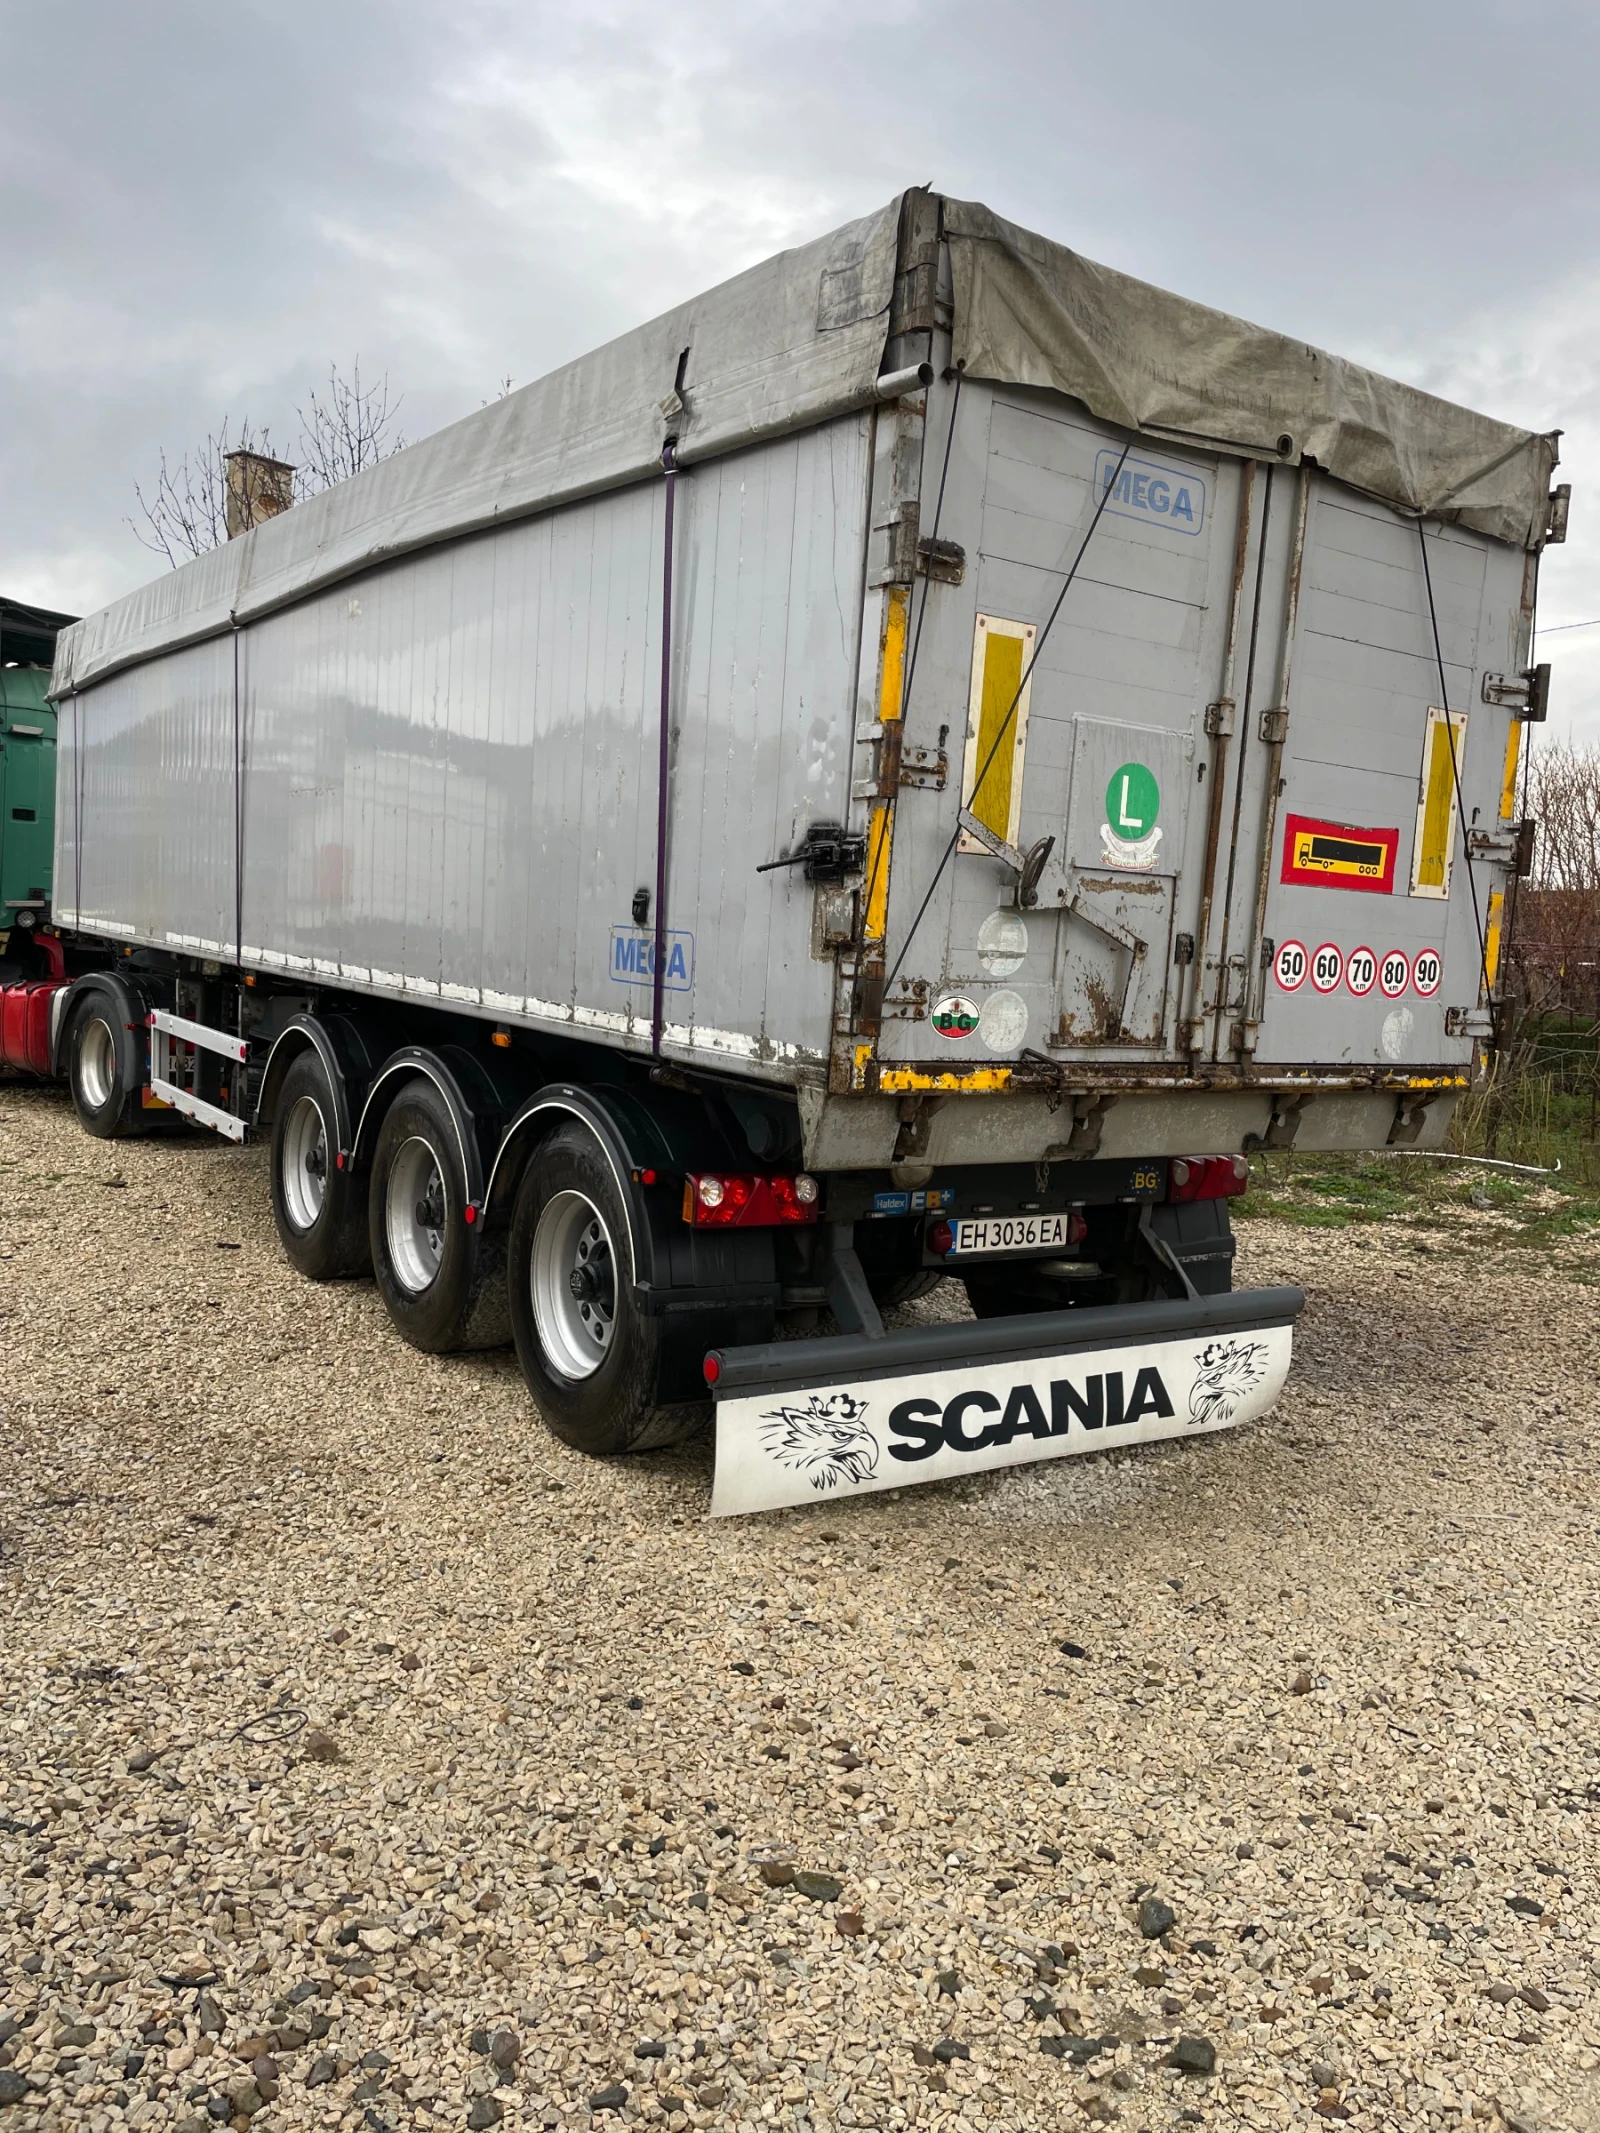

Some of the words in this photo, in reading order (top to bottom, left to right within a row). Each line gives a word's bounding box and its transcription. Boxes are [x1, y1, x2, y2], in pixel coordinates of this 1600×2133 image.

[1102, 464, 1194, 522] MEGA
[1119, 774, 1143, 828] L
[1281, 951, 1303, 976] 50
[1316, 954, 1338, 979] 60
[1352, 959, 1373, 982] 70
[1384, 961, 1405, 984] 80
[1417, 959, 1437, 982] 90
[939, 1012, 971, 1031] BG
[1134, 1172, 1157, 1189] BG
[876, 1198, 906, 1209] Haldex
[911, 1189, 951, 1209] EB+
[887, 1365, 1176, 1462] SCANIA
